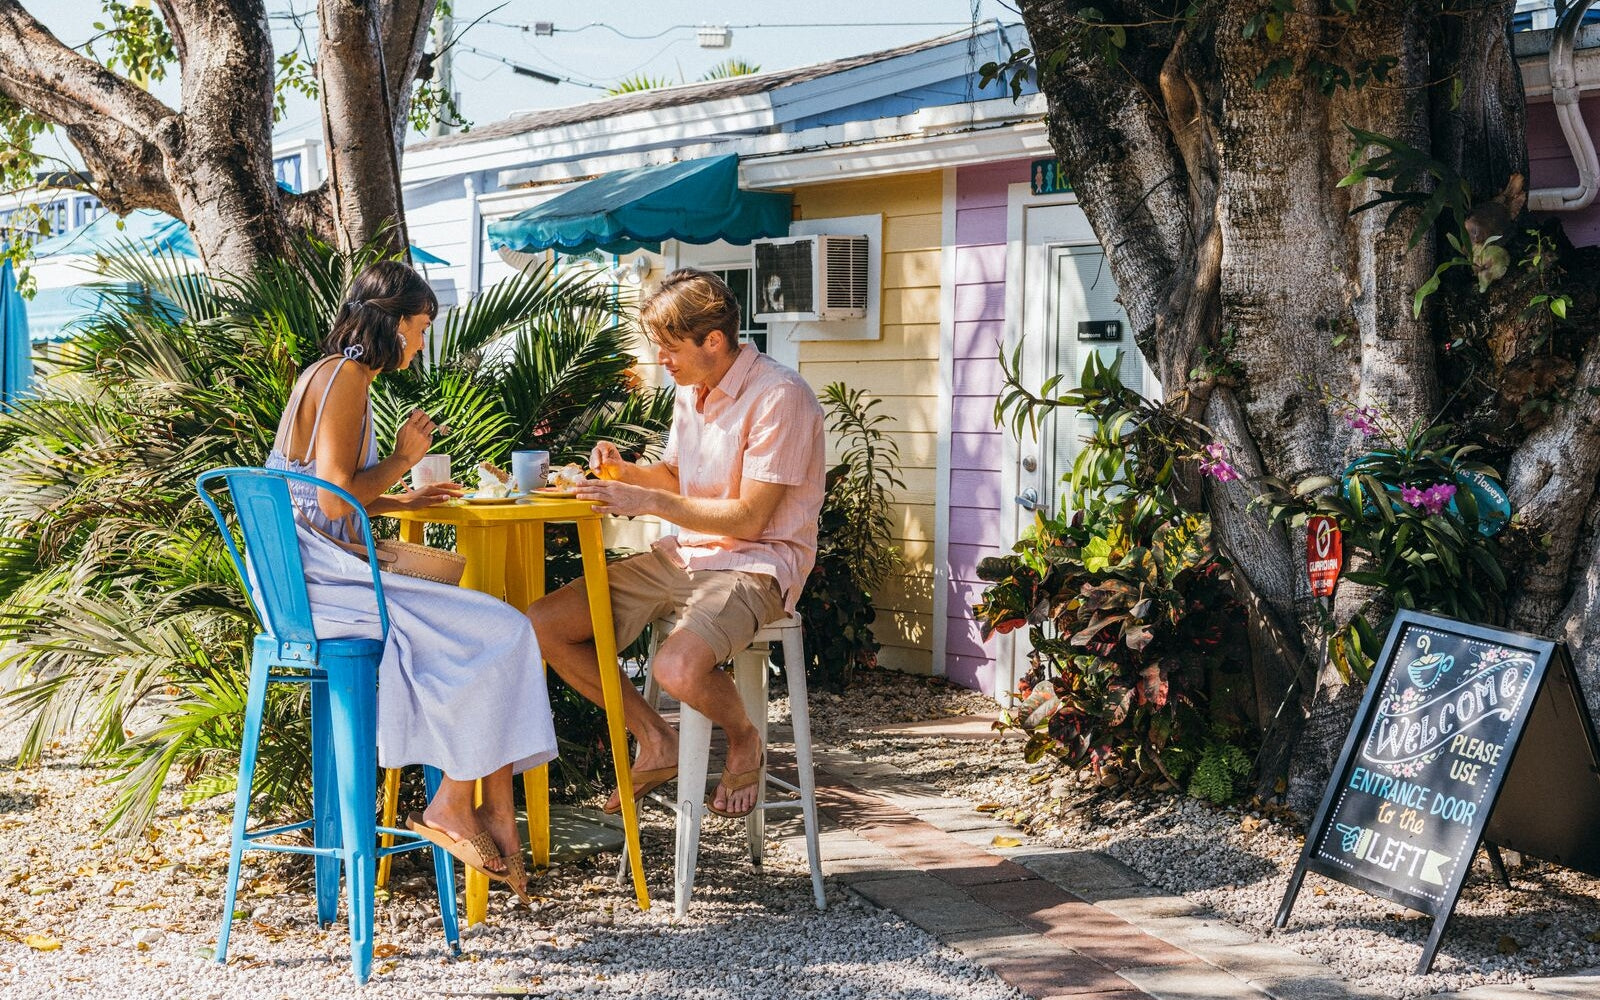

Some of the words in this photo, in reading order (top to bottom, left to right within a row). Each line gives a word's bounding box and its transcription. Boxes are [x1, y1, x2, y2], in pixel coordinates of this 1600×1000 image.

[1309, 558, 1338, 572] GUARDIAN
[1450, 734, 1504, 766] PLEASE
[1450, 760, 1481, 785] USE
[1349, 767, 1431, 810] ENTRANCE
[1430, 792, 1477, 826] DOOR
[1378, 801, 1396, 824] to
[1399, 806, 1425, 835] the
[1365, 832, 1427, 877] LEFT
